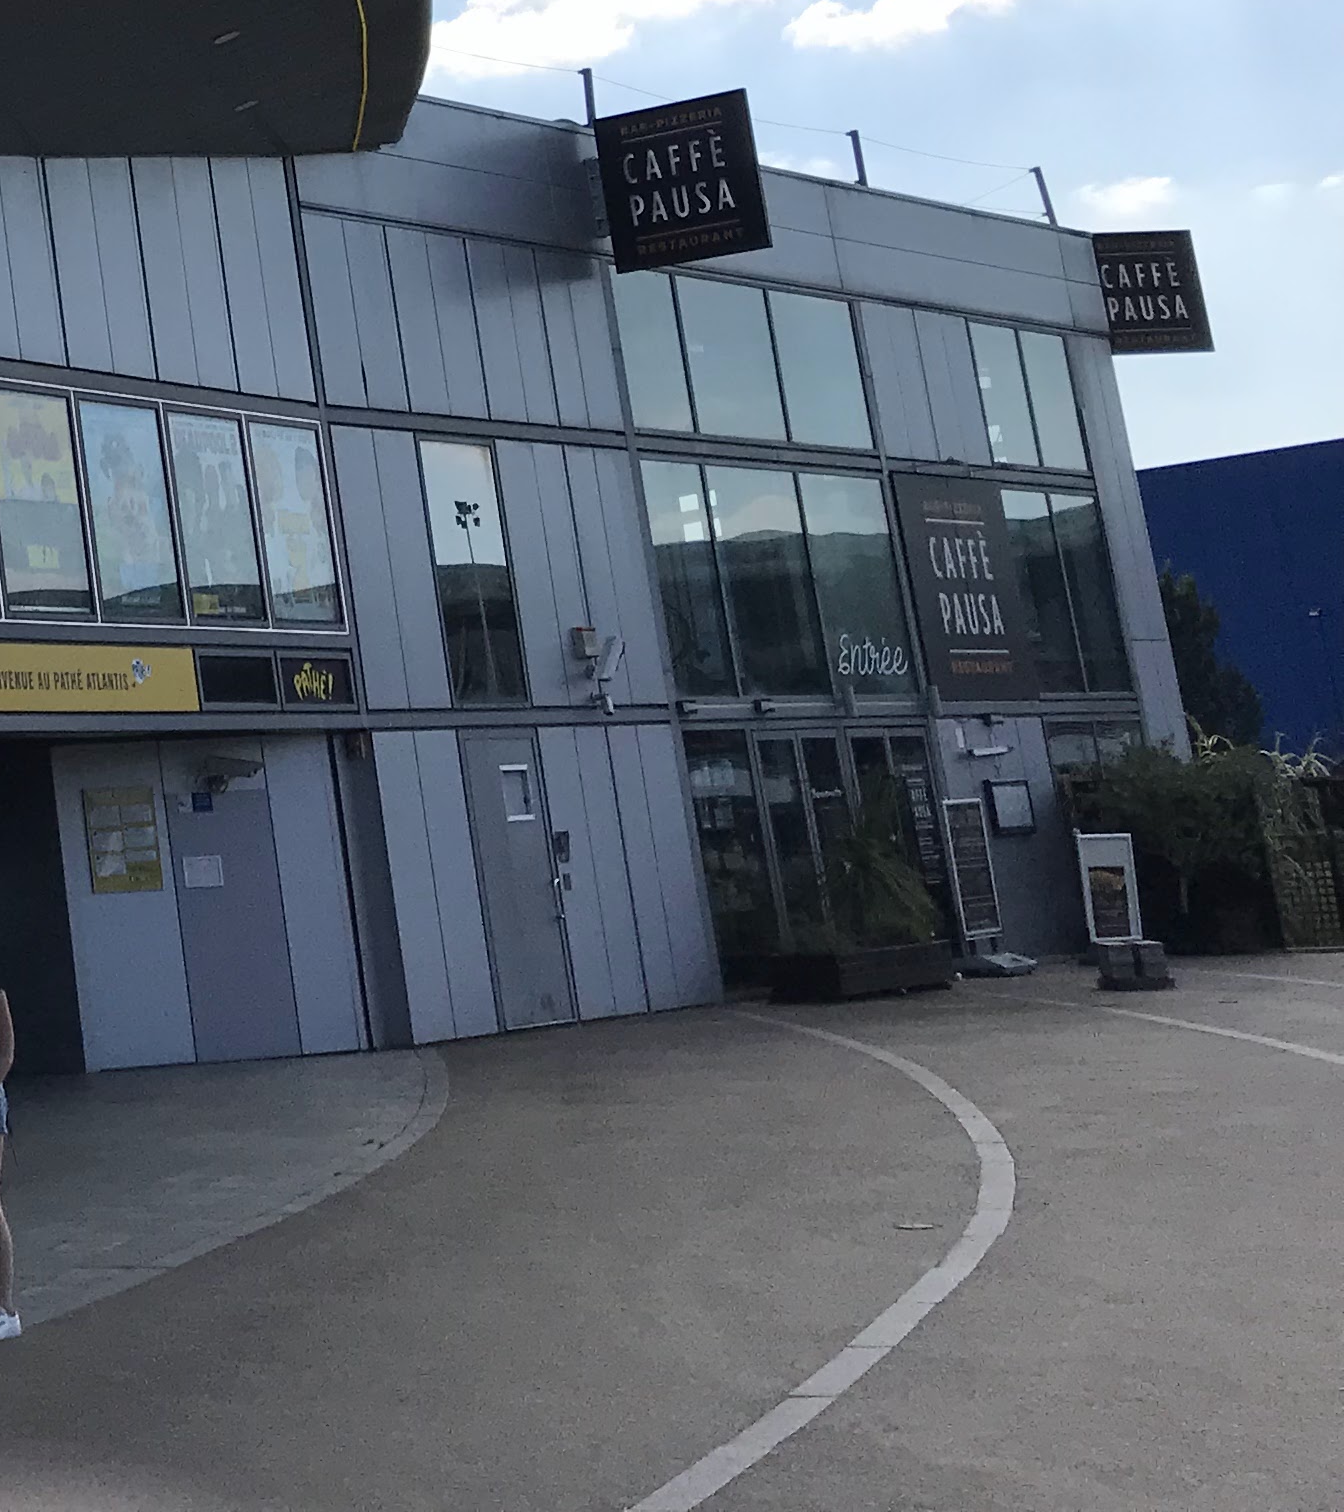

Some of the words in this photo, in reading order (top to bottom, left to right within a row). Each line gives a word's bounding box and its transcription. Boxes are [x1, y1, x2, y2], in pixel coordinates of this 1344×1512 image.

[623, 128, 727, 185] CAFFÈ
[629, 178, 736, 227] PAUSA
[636, 227, 744, 256] RESTAURANT
[1100, 256, 1180, 289] CAFFÈ
[1107, 294, 1189, 321] PAUSA
[929, 530, 994, 581] CAFFÈ
[939, 592, 1005, 636] PAUSA
[838, 633, 909, 675] Entrée
[37, 671, 50, 690] AU
[53, 668, 84, 691] PATHÉ
